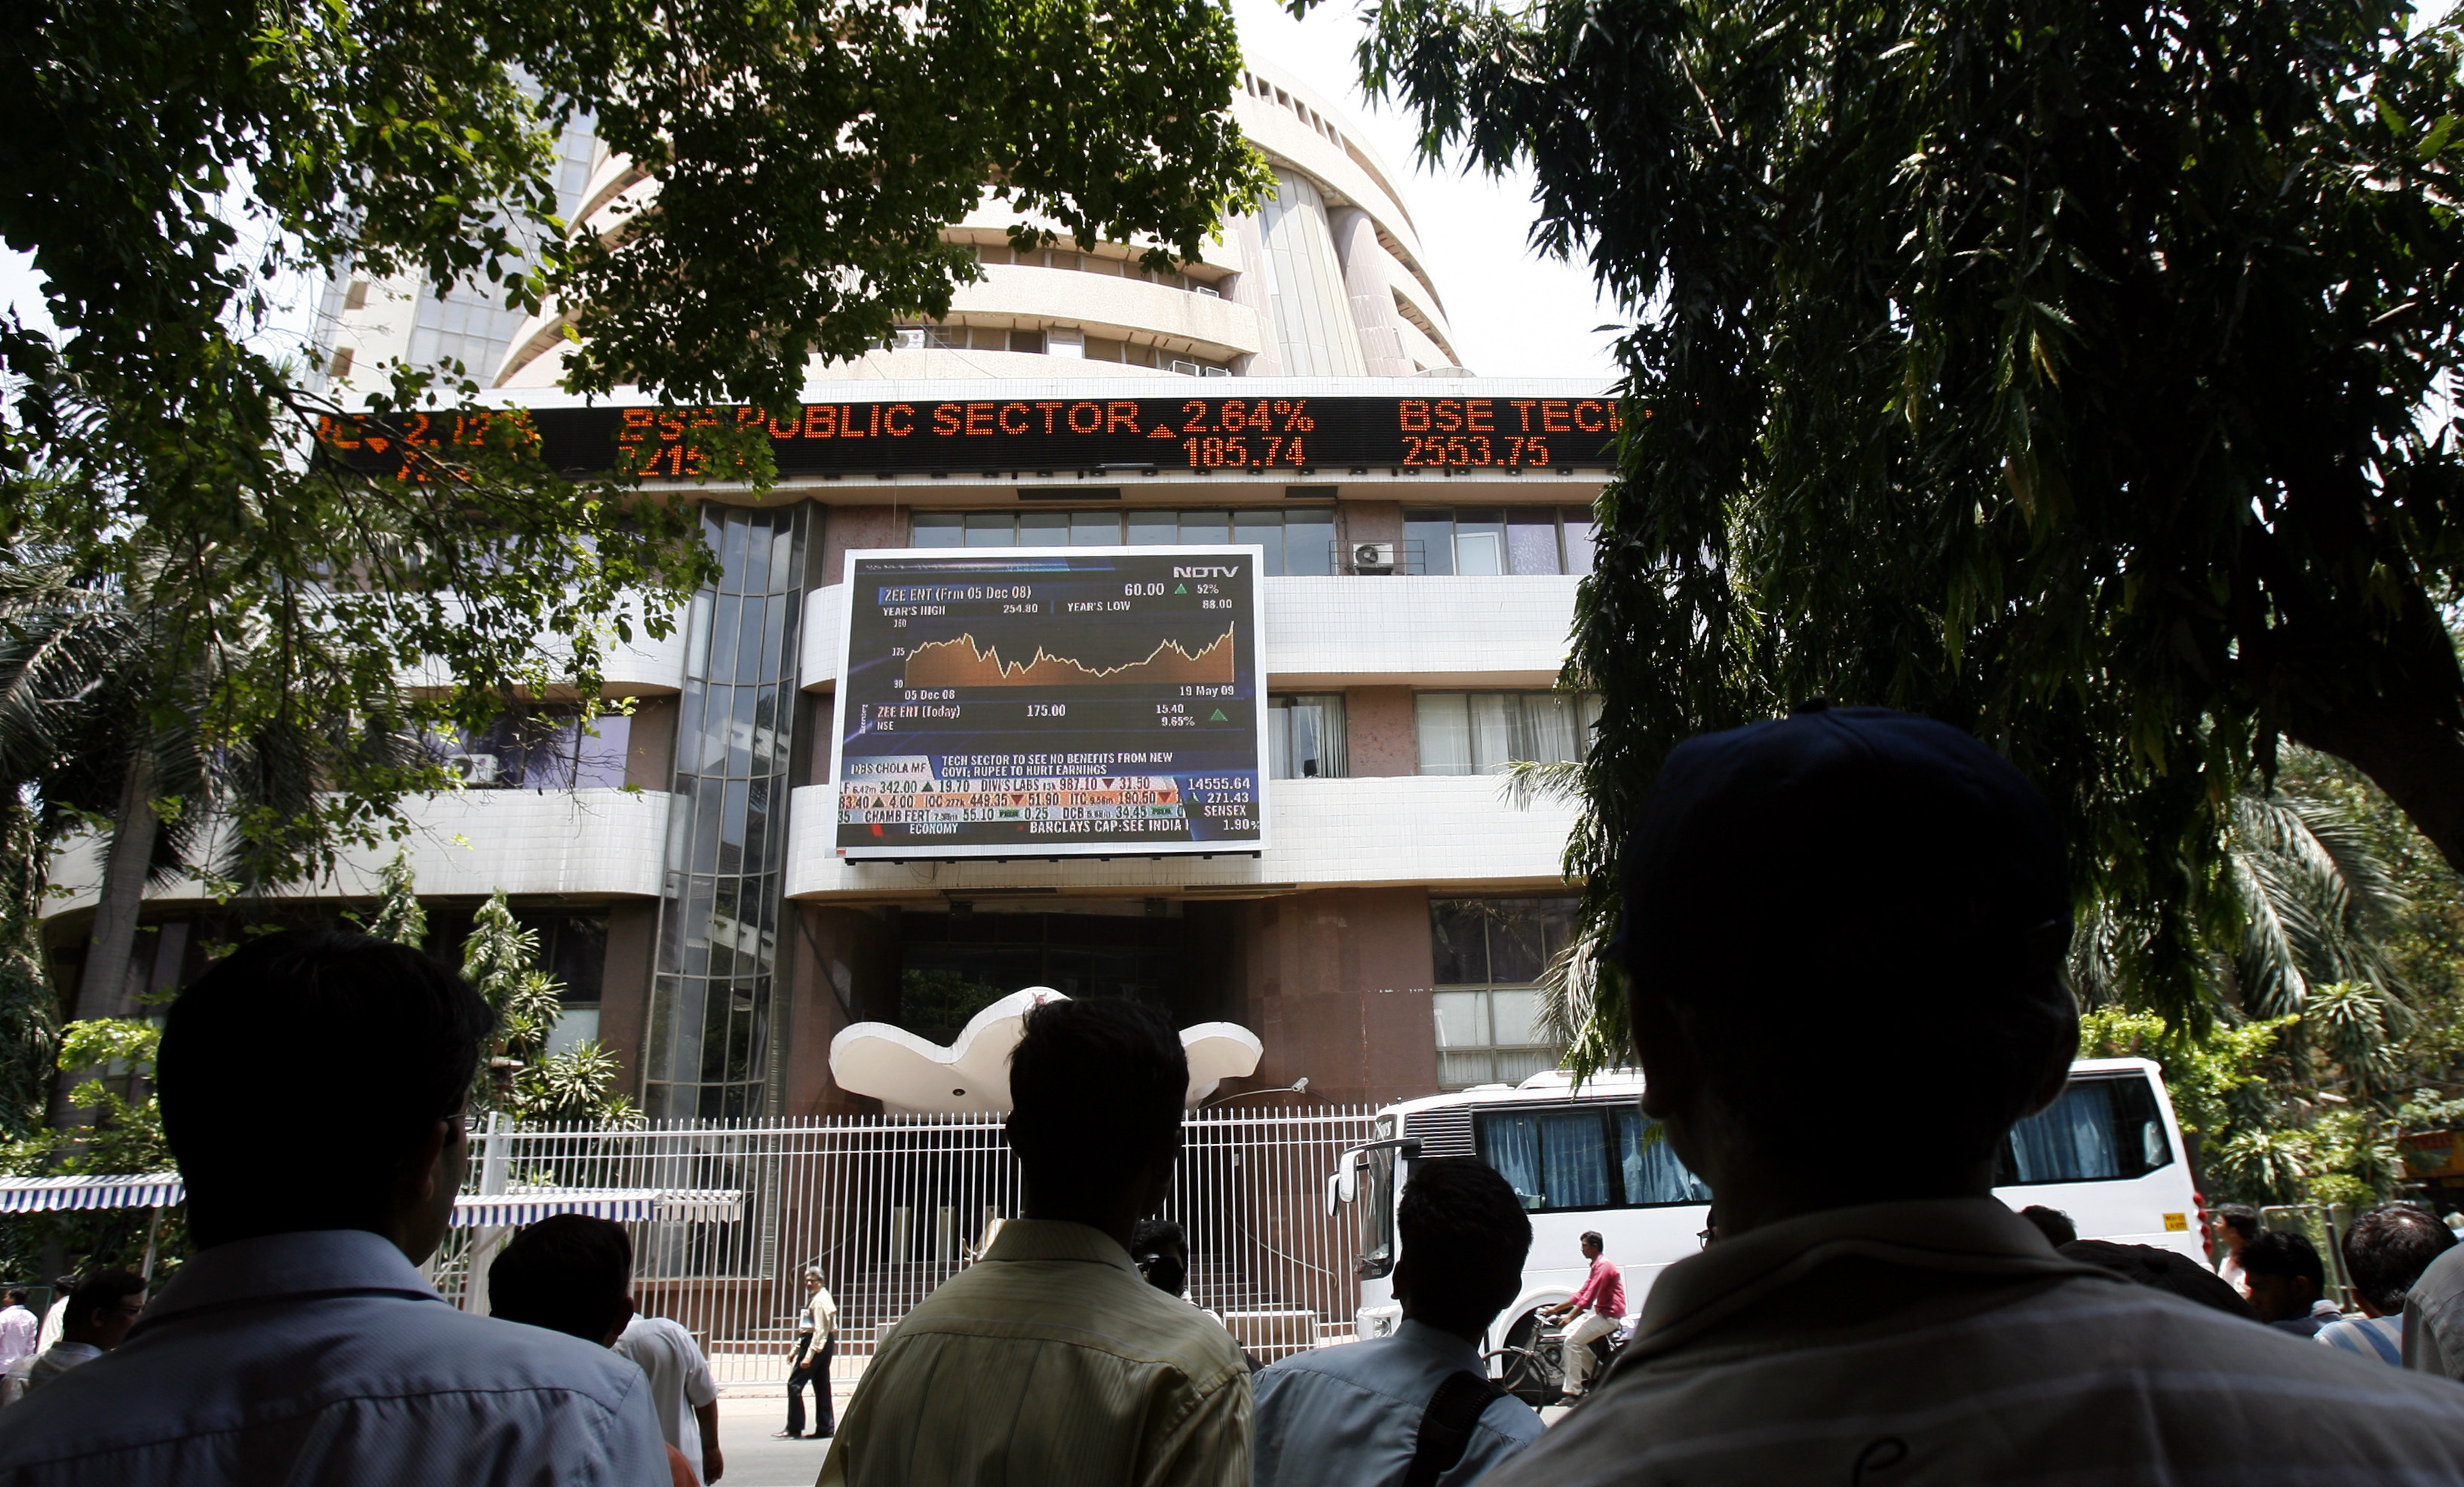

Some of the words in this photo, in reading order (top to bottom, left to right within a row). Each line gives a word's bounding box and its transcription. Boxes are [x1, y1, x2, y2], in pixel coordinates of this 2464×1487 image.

[736, 403, 915, 439] PUBLIC
[932, 400, 1141, 436] SECTOR
[1181, 399, 1314, 434] 2.64%
[1399, 399, 1495, 433] BSE
[1181, 435, 1306, 468] 185.74
[1401, 435, 1549, 468] 2553.75
[1173, 566, 1239, 578] NDTV
[884, 589, 906, 602] ZEE
[910, 588, 931, 601] ENT
[967, 587, 981, 599] 05
[986, 586, 1008, 599] Dec
[1012, 585, 1031, 599] 08)
[1124, 583, 1165, 596] 60.00
[1197, 584, 1219, 594] 52%
[883, 607, 917, 617] YEAR'S
[920, 606, 945, 615] HIGH
[1068, 602, 1103, 612] YEAR'S
[1107, 601, 1131, 611] LOW
[905, 690, 917, 701] 05
[920, 689, 939, 700] Dec
[1179, 685, 1192, 696] 19
[1196, 685, 1218, 698] May
[1221, 685, 1234, 695] 09
[877, 706, 896, 717] ZEE
[922, 704, 961, 719] (Today)
[1026, 704, 1066, 716] 175.00
[1155, 704, 1184, 714] 15.40
[877, 721, 893, 730] NSE
[942, 755, 967, 765] TECH
[970, 754, 1010, 765] SECTOR
[1012, 754, 1025, 765] TO
[1028, 754, 1047, 765] SEE
[1050, 754, 1064, 765] NO
[1067, 753, 1114, 764] BENEFITS
[1117, 753, 1147, 763] FROM
[1150, 752, 1173, 762] NEW
[973, 765, 1007, 777] RUPEE
[1010, 765, 1023, 776] TO
[1026, 765, 1053, 776] HURT
[1056, 765, 1107, 775] EARNINGS
[880, 780, 917, 793] 342.00
[939, 780, 970, 793] 19.70
[1013, 778, 1040, 791] LABS
[1059, 777, 1097, 790] 987.10
[1188, 777, 1251, 790] 14555.64
[889, 795, 914, 808] 4.00
[1028, 793, 1059, 805] 51.90
[1070, 793, 1087, 805] ITC
[1206, 793, 1249, 803] 271.43
[865, 810, 901, 823] CHAMB
[905, 809, 930, 822] FERT
[1024, 807, 1049, 820] 0.25
[1062, 807, 1084, 820] DCB
[1116, 805, 1147, 819] 34.45
[1203, 805, 1246, 817] SENSEX
[909, 823, 959, 835] ECONOMY
[1029, 820, 1090, 834] BARCLAYS
[1148, 819, 1181, 832] INDIA
[1223, 818, 1261, 830] 1.90%
